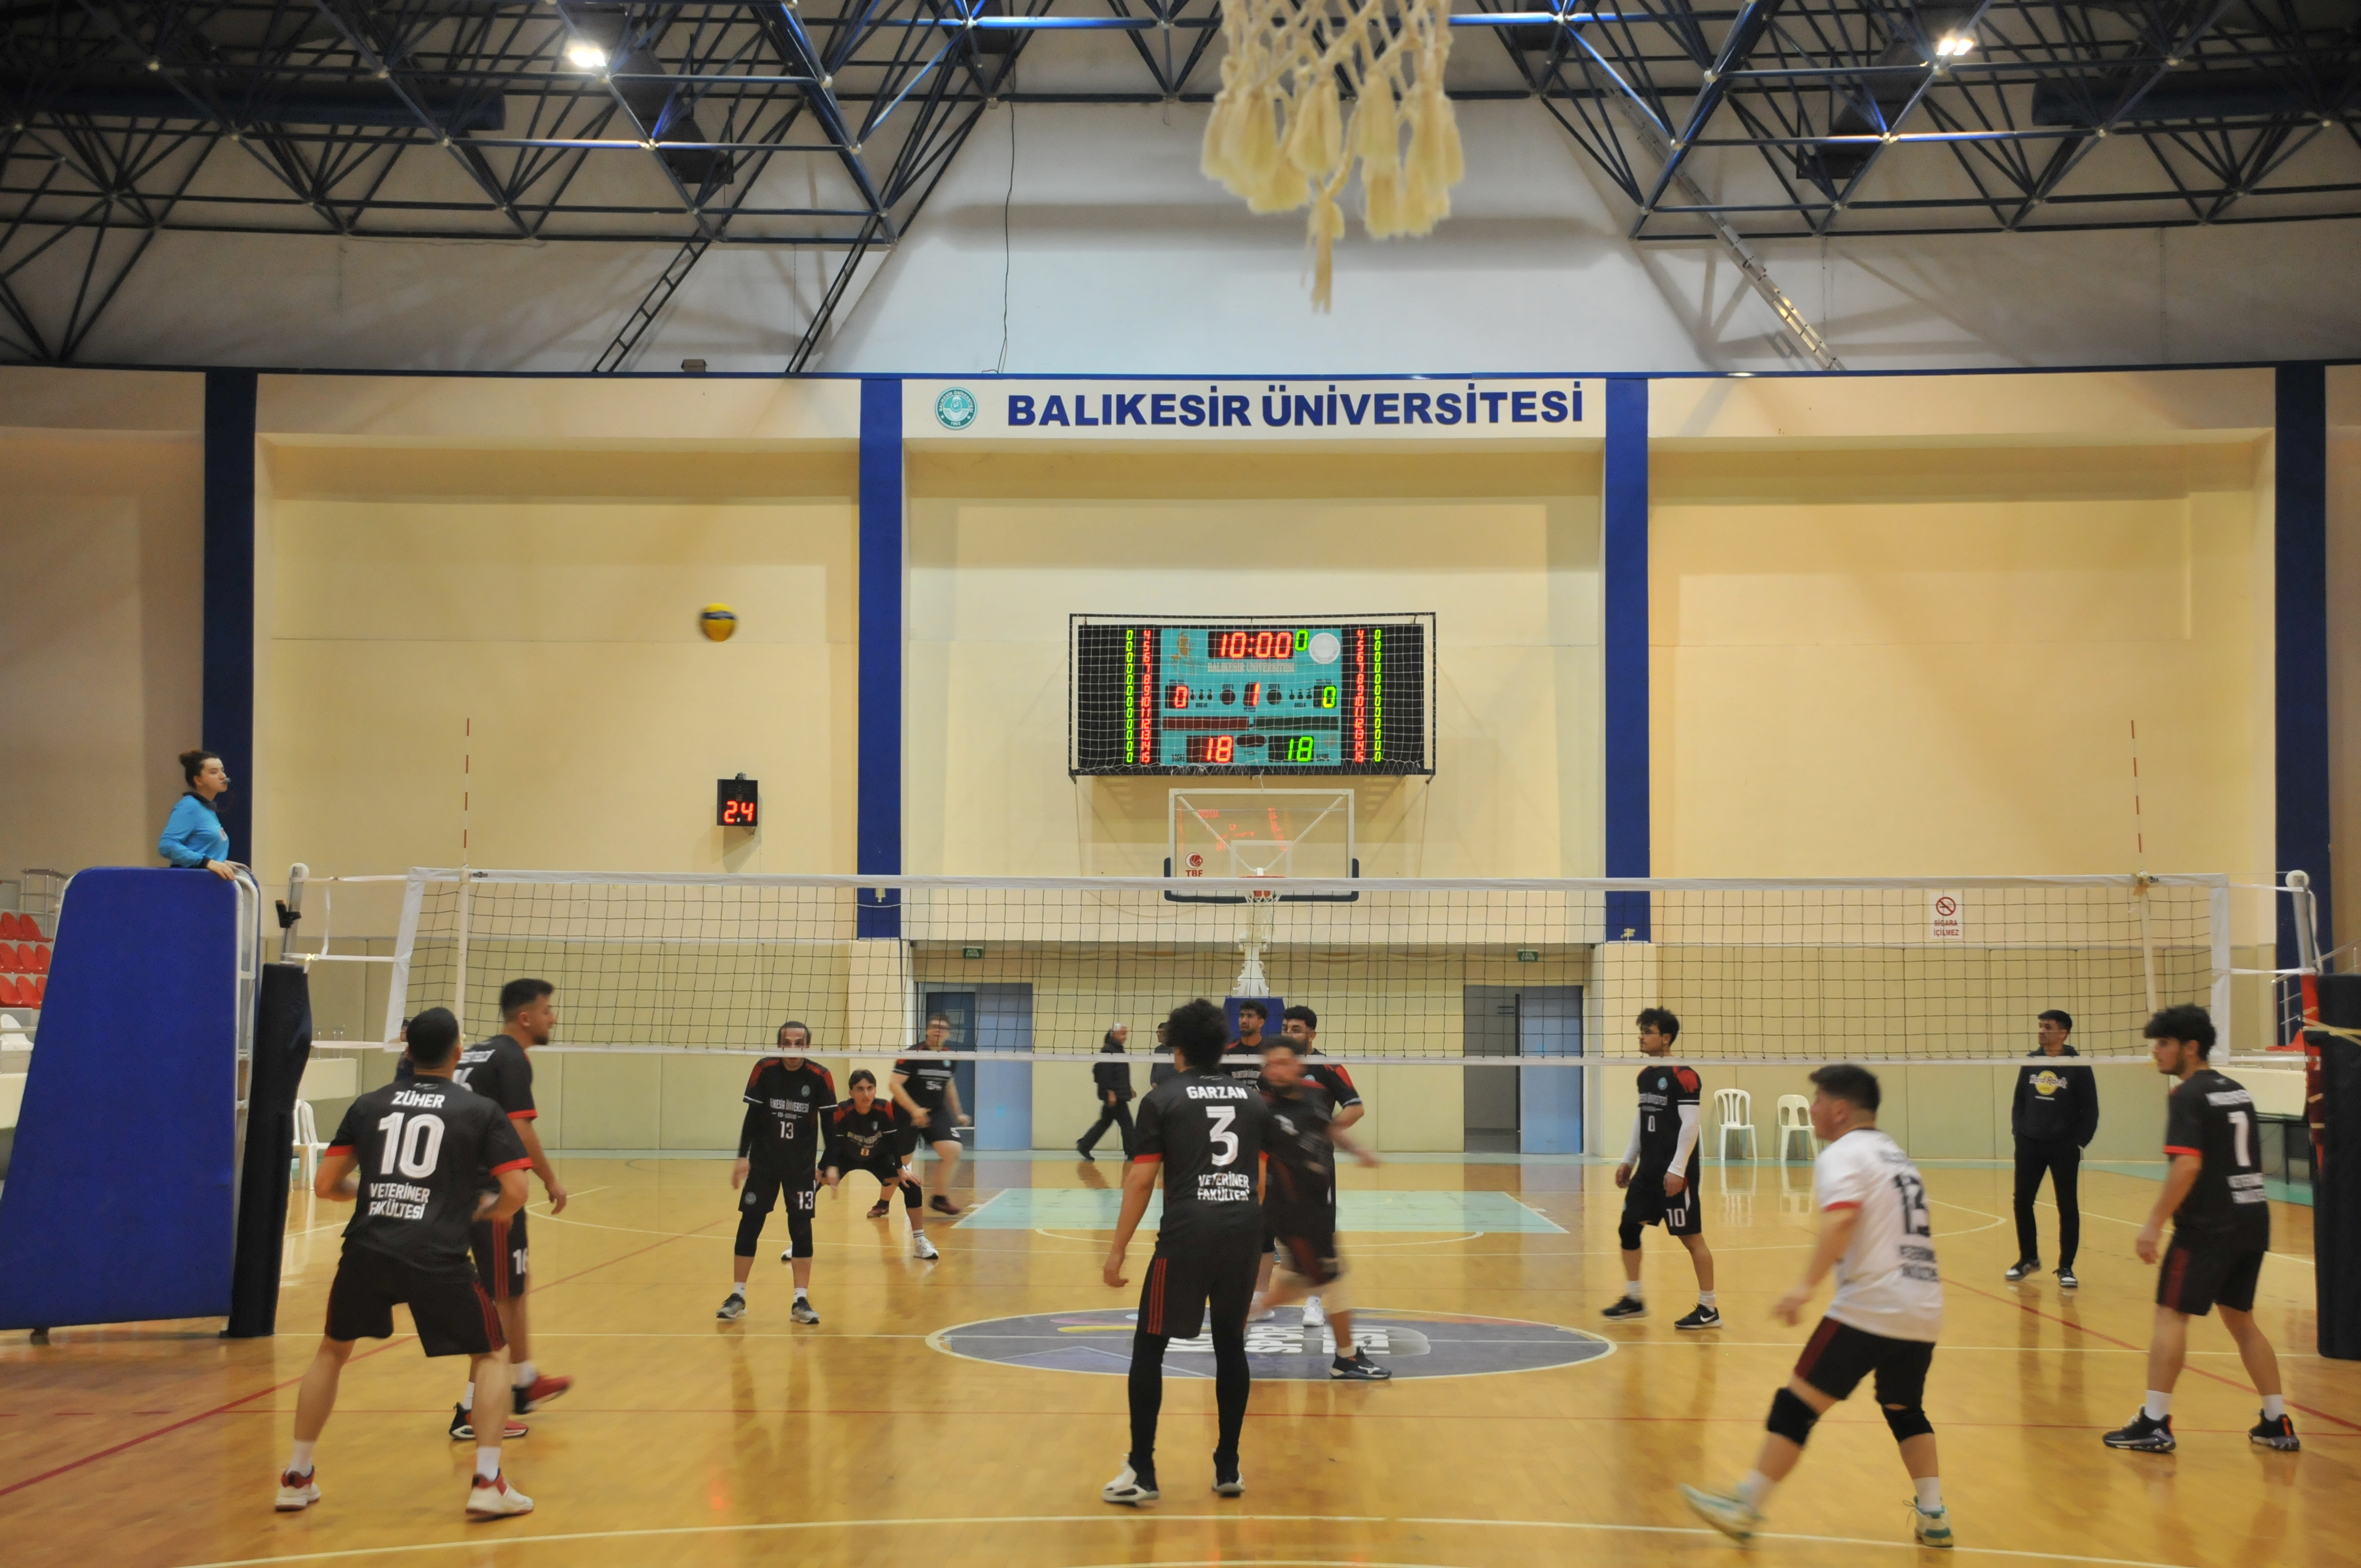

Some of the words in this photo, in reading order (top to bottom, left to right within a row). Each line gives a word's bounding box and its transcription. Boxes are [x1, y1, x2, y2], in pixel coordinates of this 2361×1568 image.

[1008, 385, 1252, 427] BALIKESİR
[1262, 381, 1582, 427] ÜNİVERSİTESİ
[1143, 630, 1151, 640] 4
[1357, 630, 1364, 640] 4
[1143, 641, 1151, 651] 5
[1220, 632, 1292, 658] 10:00
[1294, 629, 1309, 652] 0
[1357, 641, 1364, 651] 5
[1143, 652, 1151, 662] 6
[1357, 652, 1364, 662] 6
[1143, 663, 1151, 673] 7
[1357, 663, 1364, 673] 7
[1143, 674, 1151, 684] 8
[1357, 674, 1364, 684] 8
[1143, 685, 1151, 695] 9
[1253, 683, 1260, 706] 1
[1357, 685, 1364, 695] 9
[1141, 696, 1151, 706] 10
[1174, 686, 1188, 708] 0
[1323, 686, 1337, 708] 0
[1354, 696, 1364, 706] 10
[1141, 708, 1151, 718] 11
[1354, 707, 1364, 717] 11
[1141, 719, 1151, 729] 12
[1354, 718, 1364, 728] 12
[1141, 730, 1151, 740] 13
[1354, 729, 1364, 739] 13
[1141, 741, 1151, 751] 14
[1206, 736, 1233, 762] 18
[1288, 736, 1313, 762] 18
[1354, 740, 1364, 750] 14
[1141, 752, 1151, 762] 15
[1354, 752, 1364, 761] 15
[724, 801, 754, 823] 24
[1933, 928, 1959, 937] İÇİLMEZ
[1186, 1086, 1248, 1099] GARZAN
[391, 1090, 445, 1108] ZÜHER
[780, 1121, 794, 1139] 13
[1206, 1106, 1238, 1166] 3
[2228, 1111, 2251, 1167] 1
[379, 1112, 445, 1178] 10
[1198, 1171, 1249, 1188] VETERİNER
[371, 1183, 430, 1202] VETERİNER
[797, 1191, 814, 1210] 13
[369, 1199, 426, 1219] FAKÜLTESİ
[1666, 1208, 1686, 1227] 10
